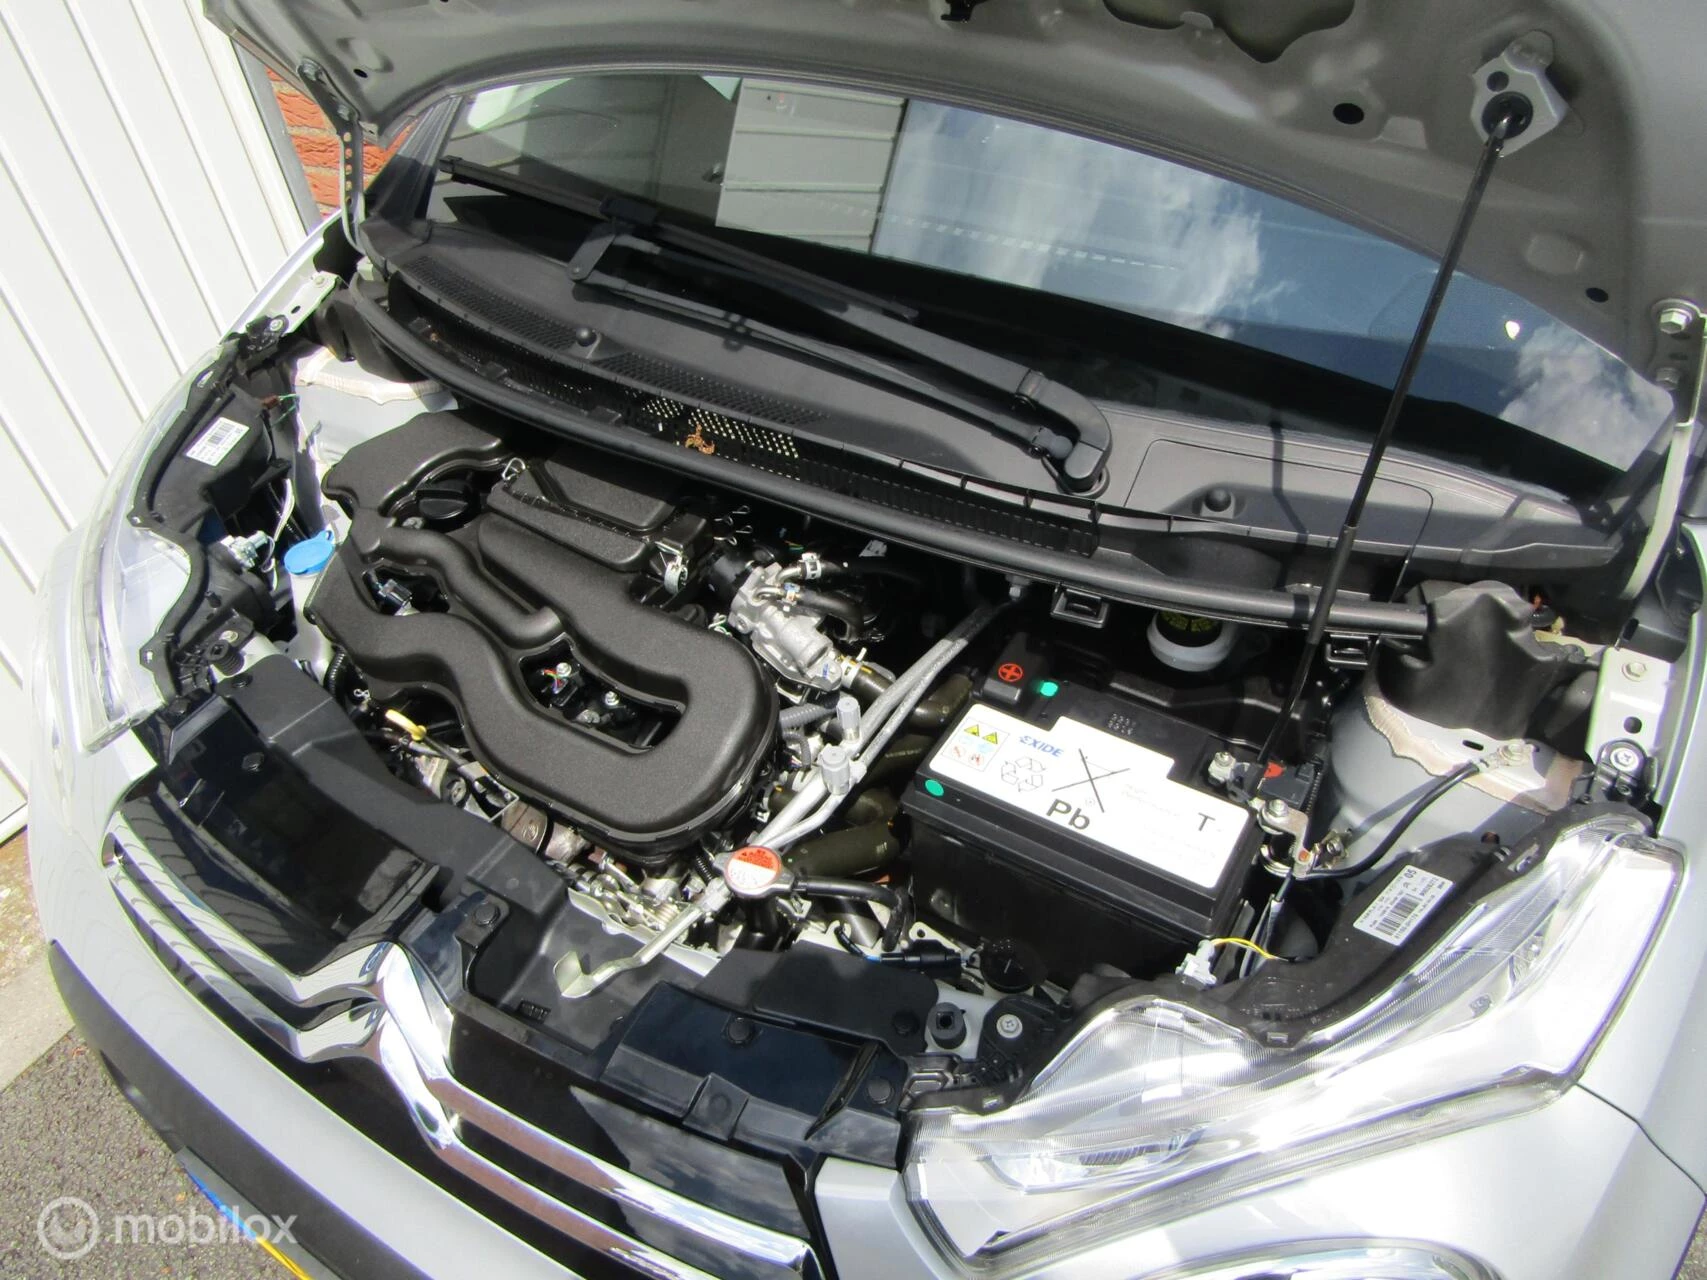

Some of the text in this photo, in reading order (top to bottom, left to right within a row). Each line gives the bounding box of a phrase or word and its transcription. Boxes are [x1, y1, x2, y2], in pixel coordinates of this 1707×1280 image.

[1019, 735, 1064, 757] EXIDE
[1046, 798, 1090, 830] Pb
[1198, 812, 1216, 831] T
